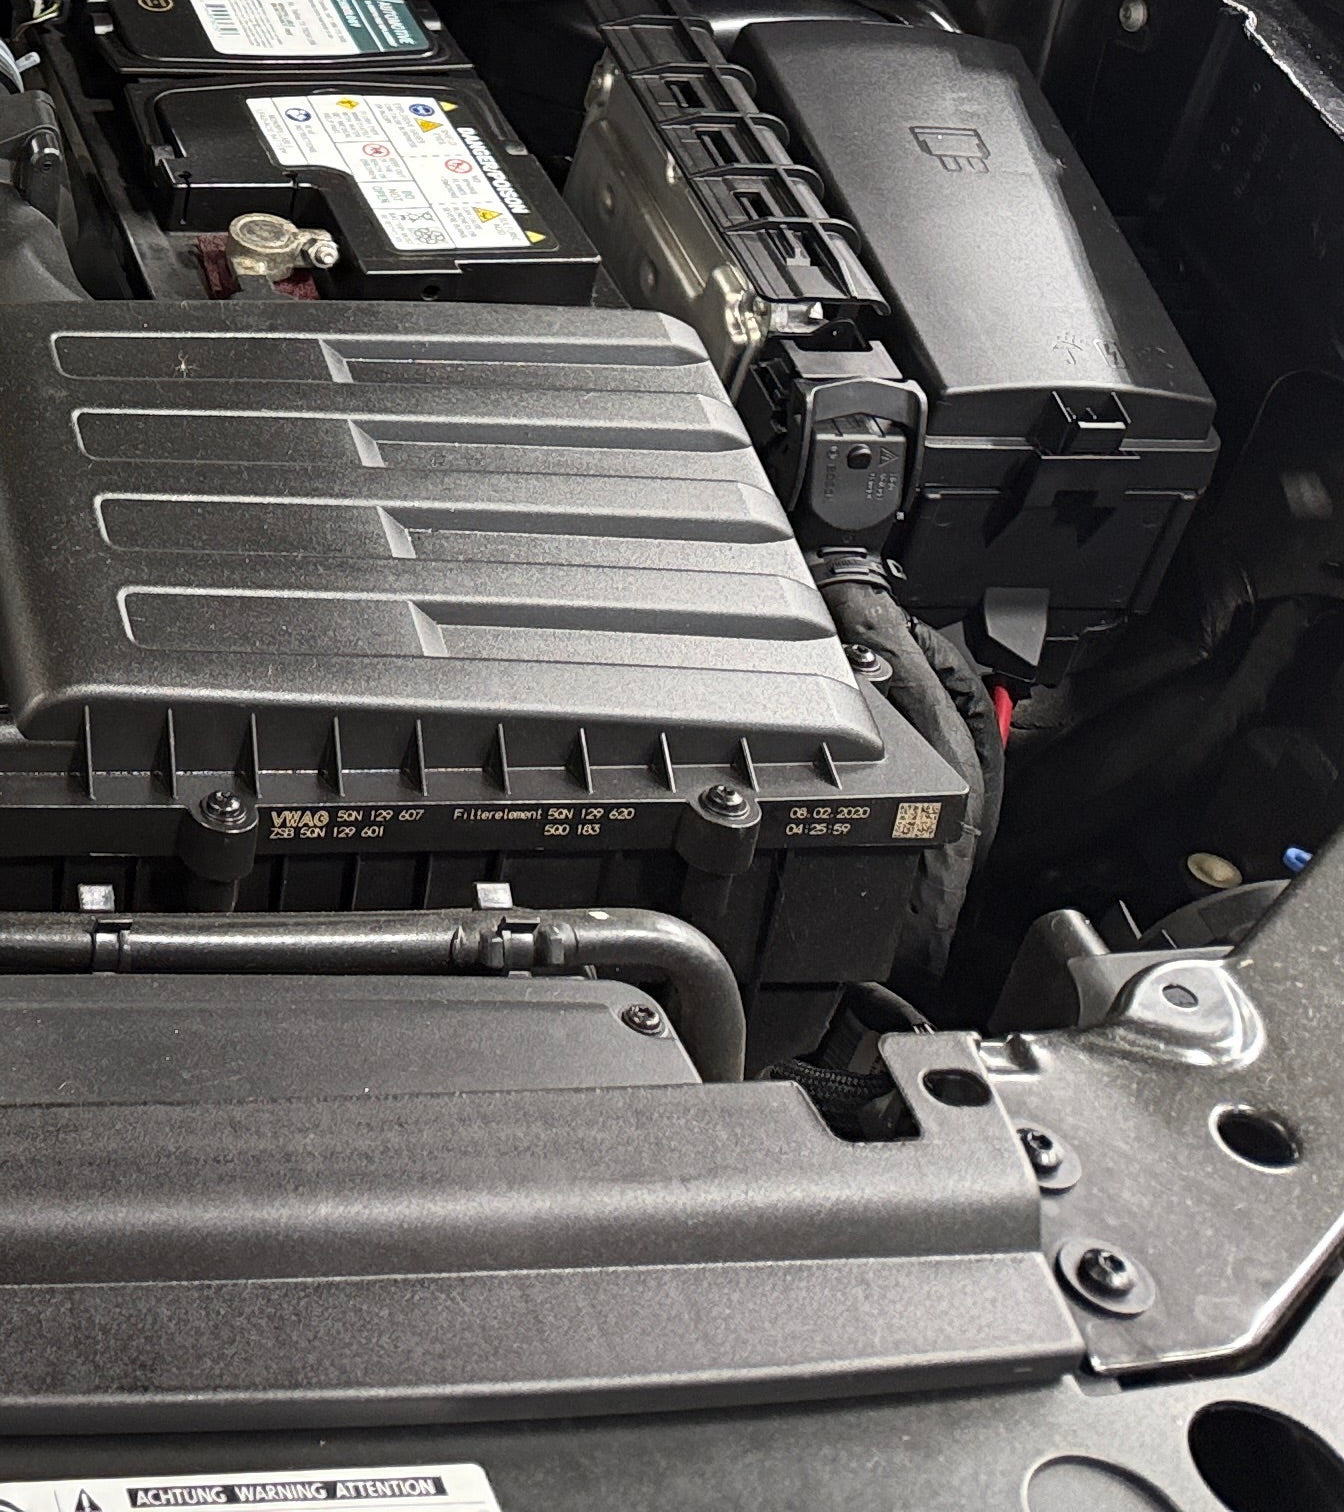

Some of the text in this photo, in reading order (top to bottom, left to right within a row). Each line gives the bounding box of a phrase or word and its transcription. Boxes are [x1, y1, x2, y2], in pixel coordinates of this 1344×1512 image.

[271, 809, 425, 827] VWAG 5QN 129 607
[547, 807, 574, 820] 5QN
[581, 807, 605, 820] 129
[608, 807, 635, 820] 620
[789, 806, 871, 819] 08.02.2020
[269, 826, 385, 839] ZSB 5QN 129 601
[577, 823, 601, 836] 183
[785, 823, 851, 836] 04:25:59
[136, 1478, 436, 1506] ACHTUNG WARNING ATTENTION
